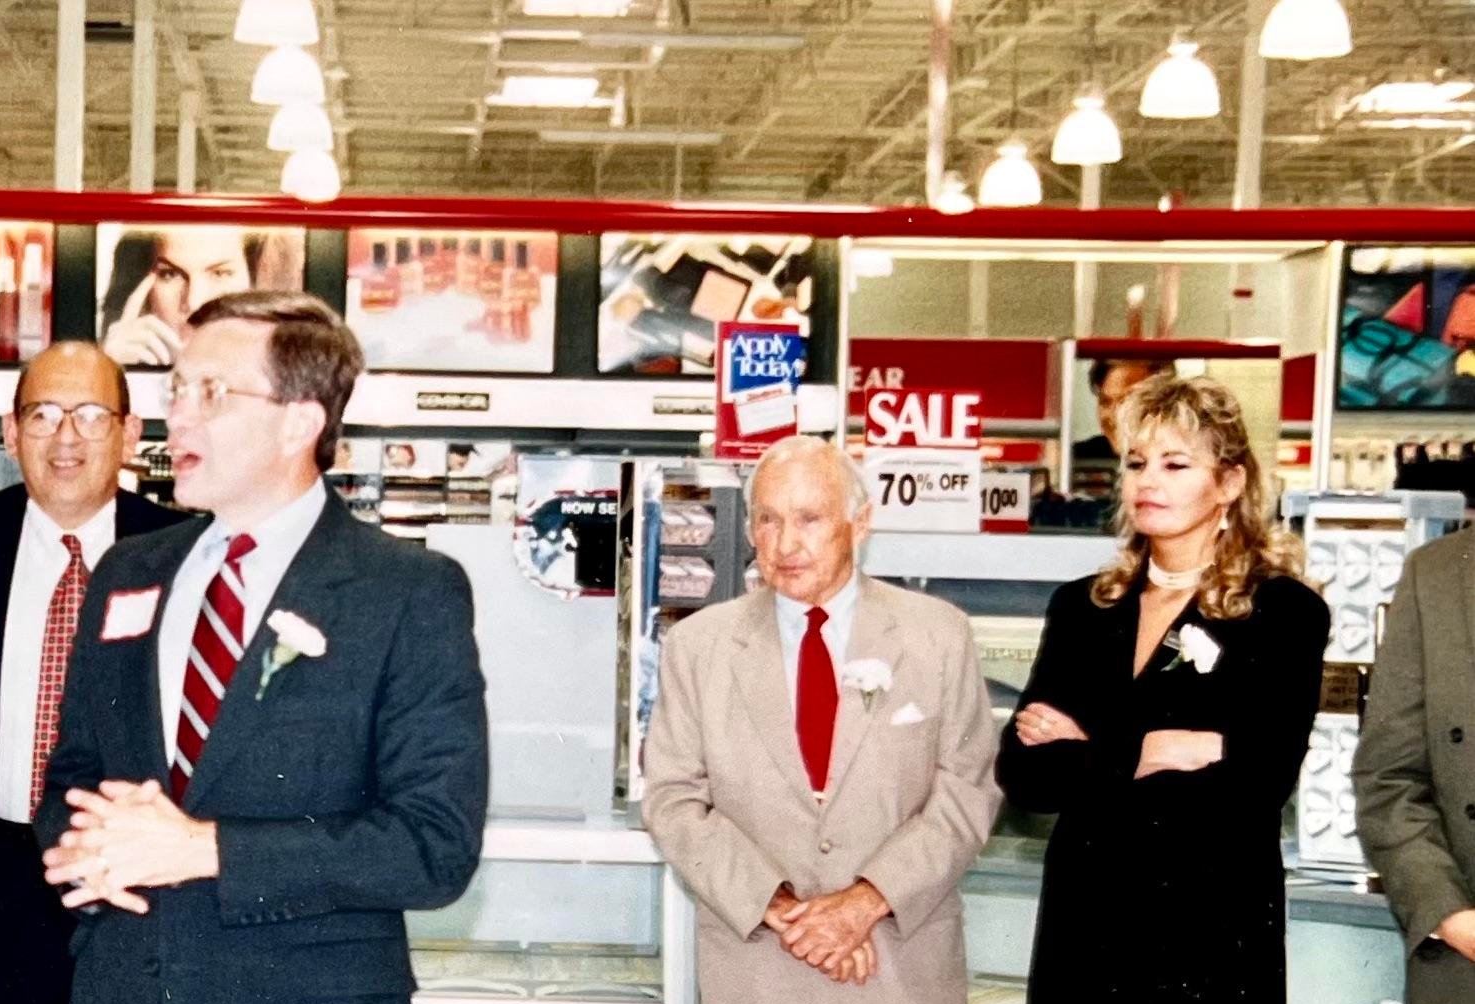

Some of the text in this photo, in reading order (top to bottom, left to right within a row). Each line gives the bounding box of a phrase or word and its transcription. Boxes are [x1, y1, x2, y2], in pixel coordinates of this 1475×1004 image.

[731, 333, 791, 361] Apply
[866, 391, 981, 446] SALE
[878, 473, 970, 506] 70% OFF
[561, 501, 596, 515] NOW
